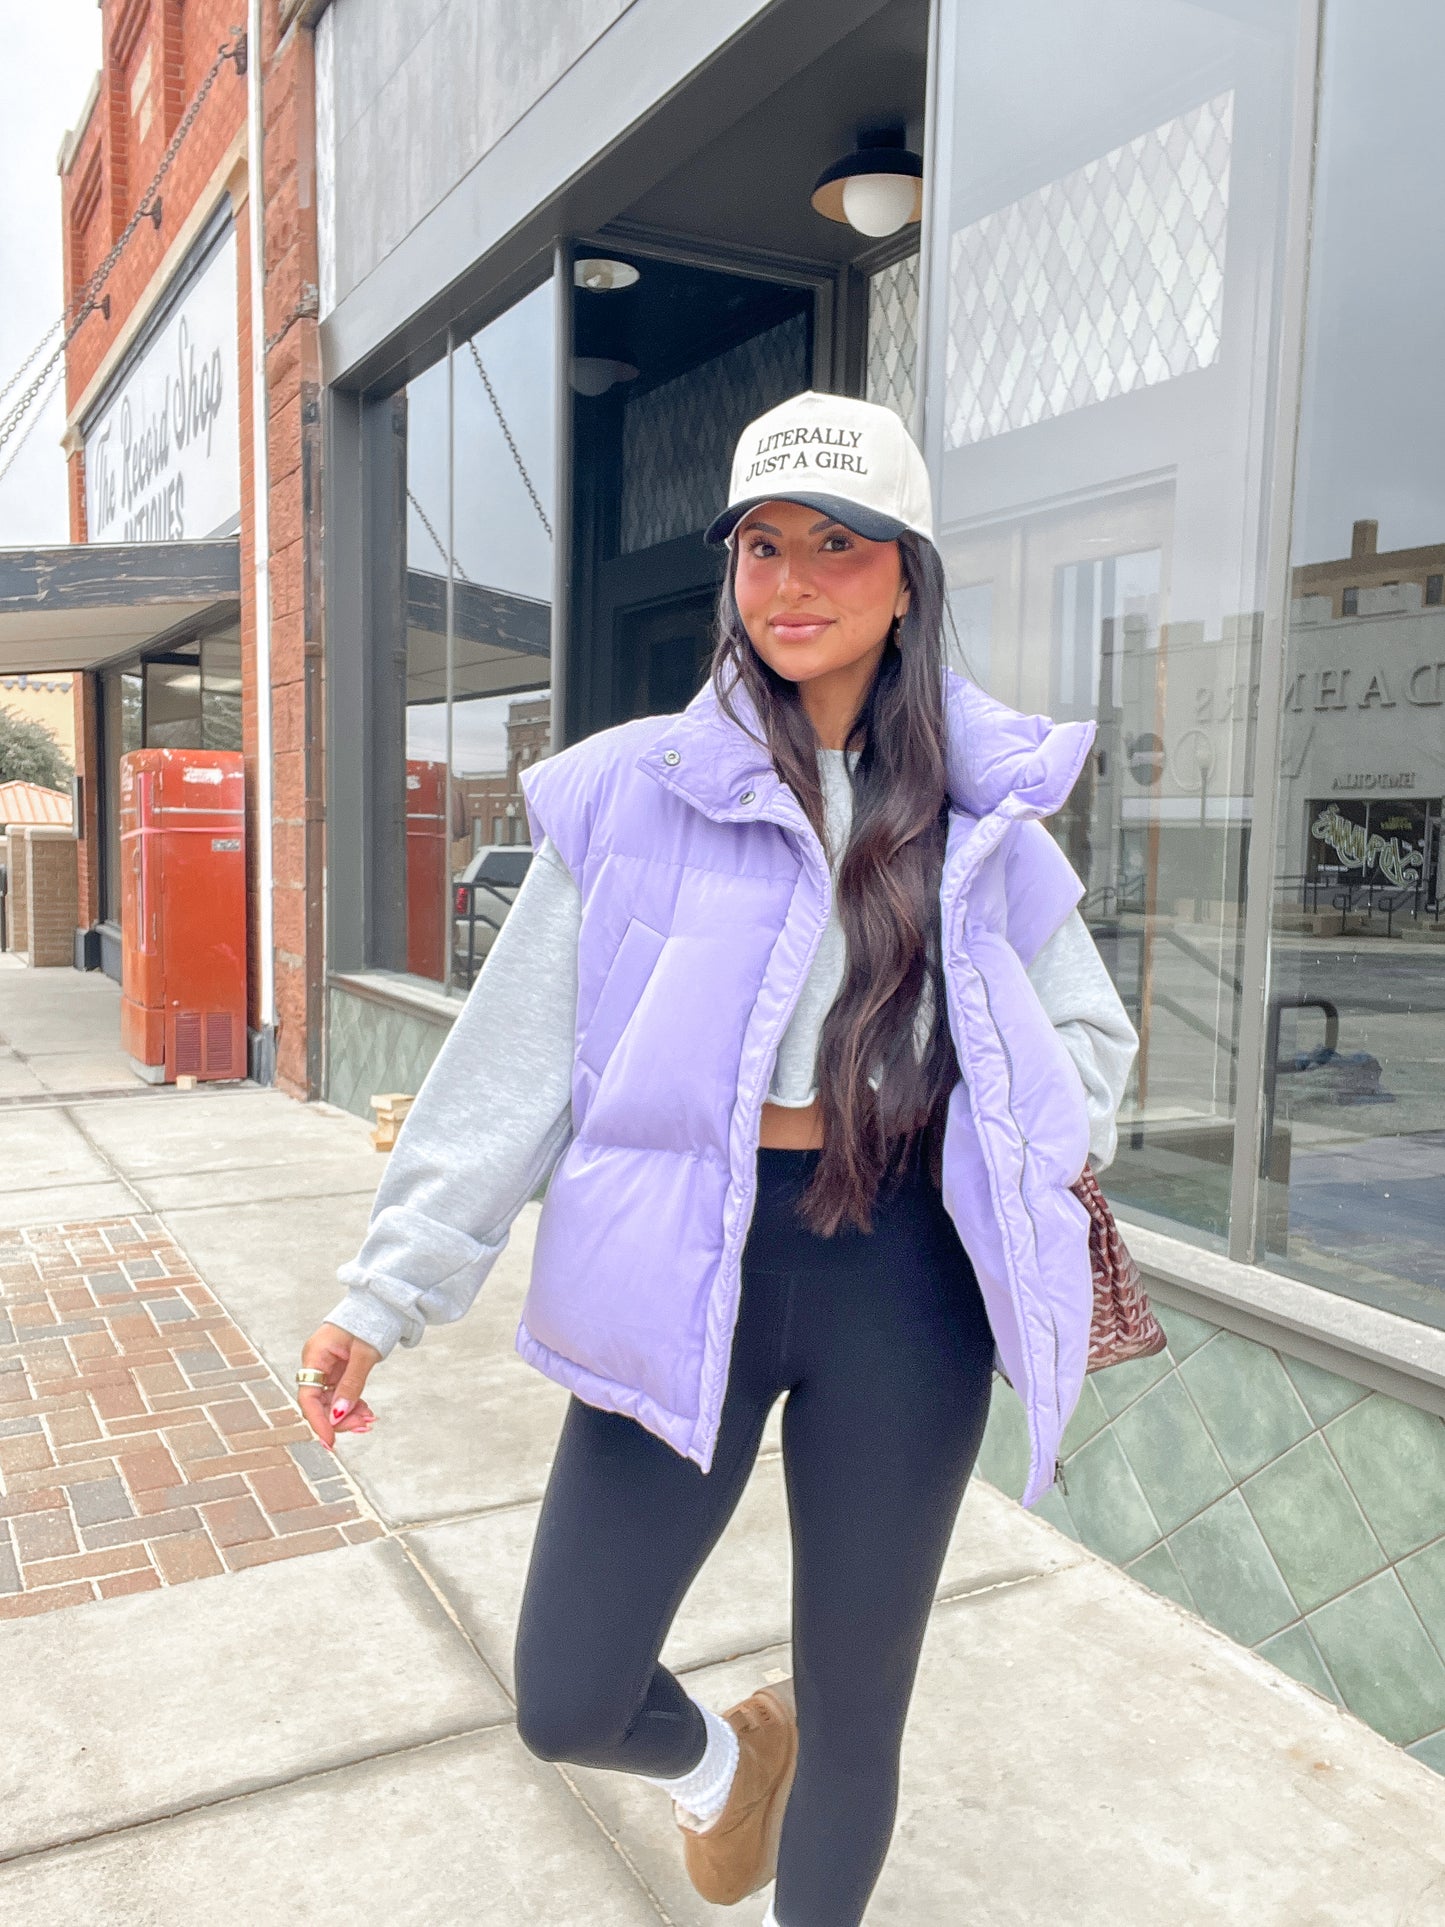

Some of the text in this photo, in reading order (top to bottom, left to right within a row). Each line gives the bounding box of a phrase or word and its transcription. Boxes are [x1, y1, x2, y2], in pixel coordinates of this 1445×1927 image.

[95, 314, 223, 537] The Record Shop
[756, 427, 863, 456] LITERALLY
[745, 451, 869, 482] JUST A GIRL
